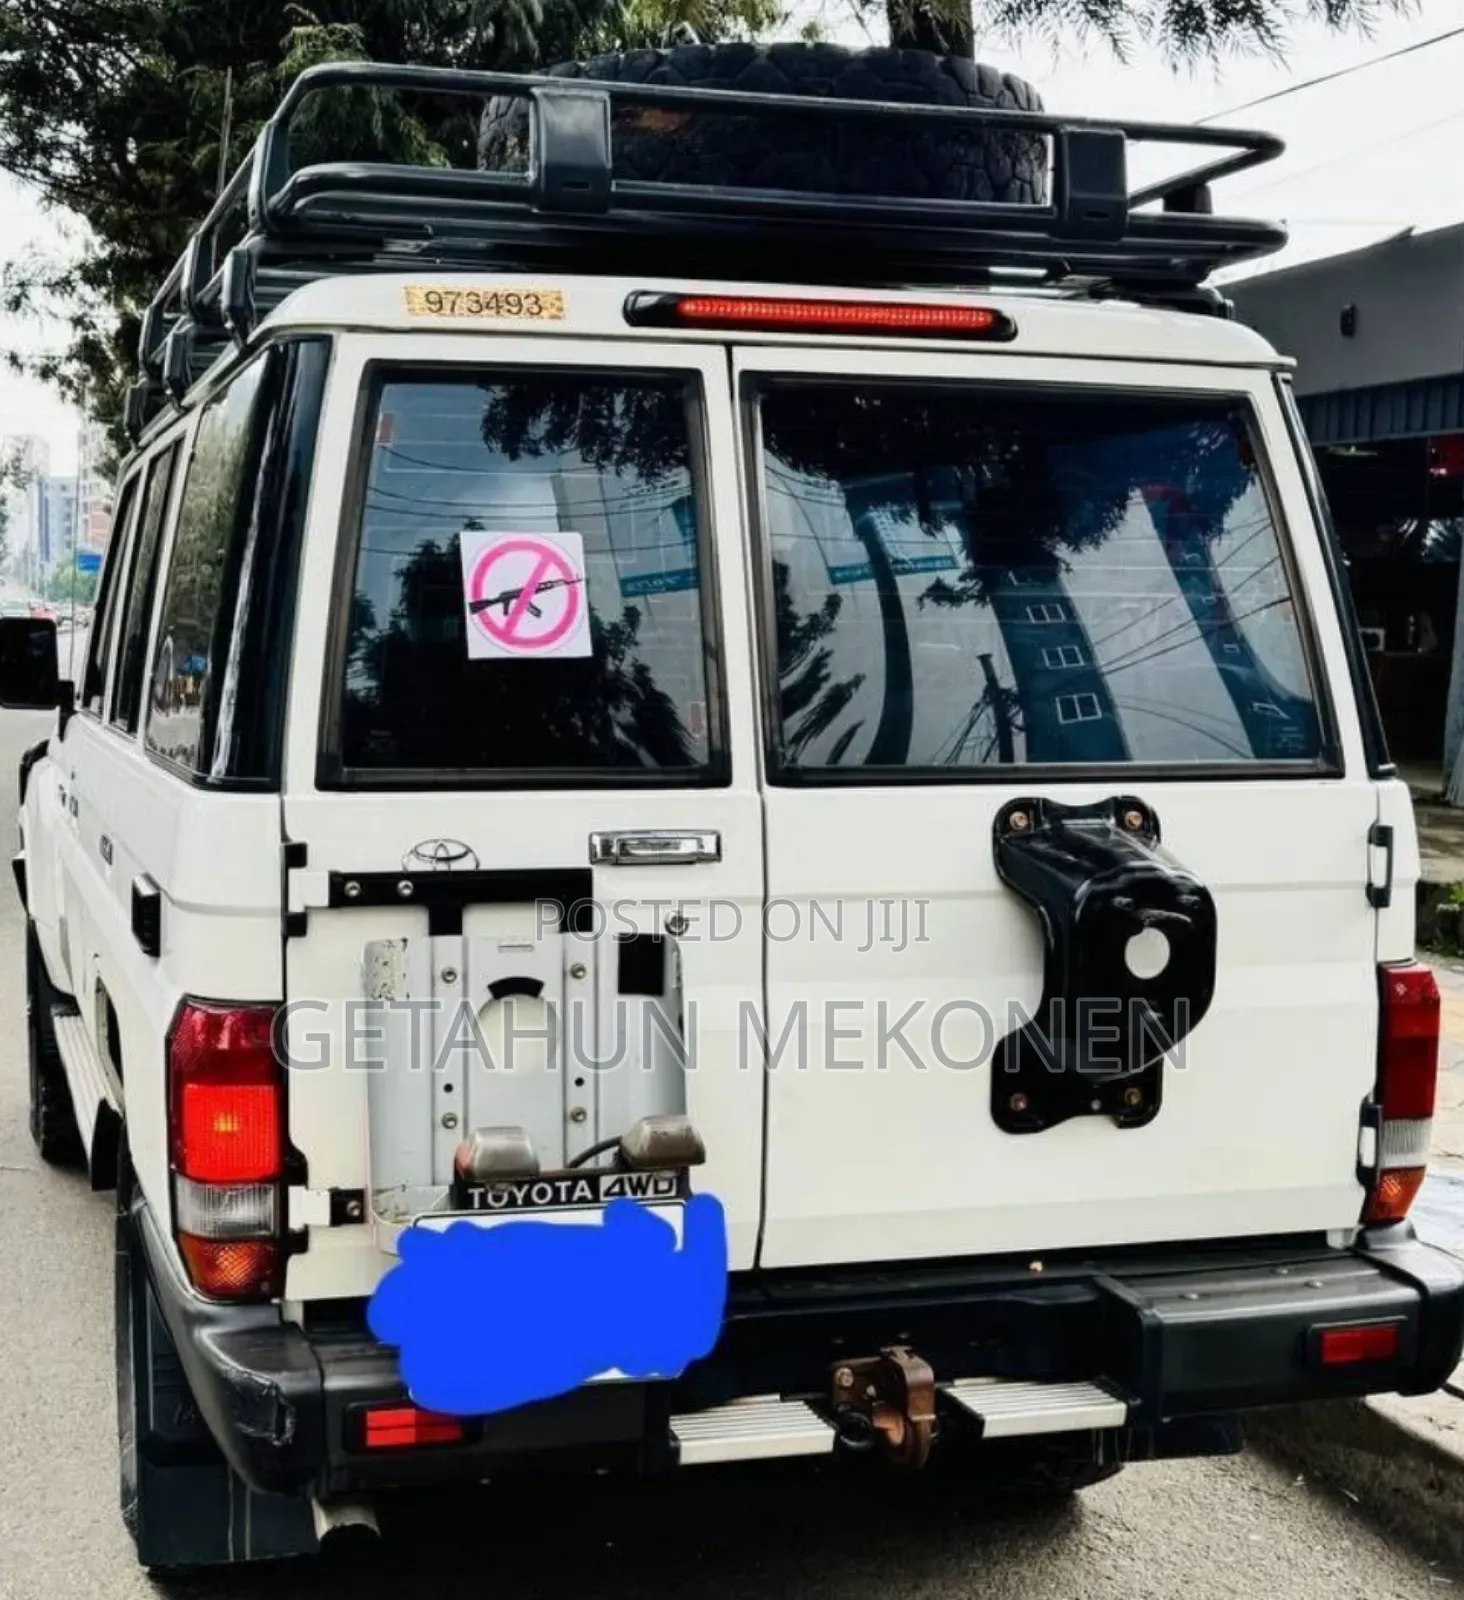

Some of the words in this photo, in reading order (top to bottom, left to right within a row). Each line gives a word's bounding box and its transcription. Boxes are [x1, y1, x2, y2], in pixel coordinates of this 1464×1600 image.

[424, 290, 543, 316] 973493
[467, 1179, 593, 1209] TOYOTA
[602, 1174, 675, 1198] 4WD
